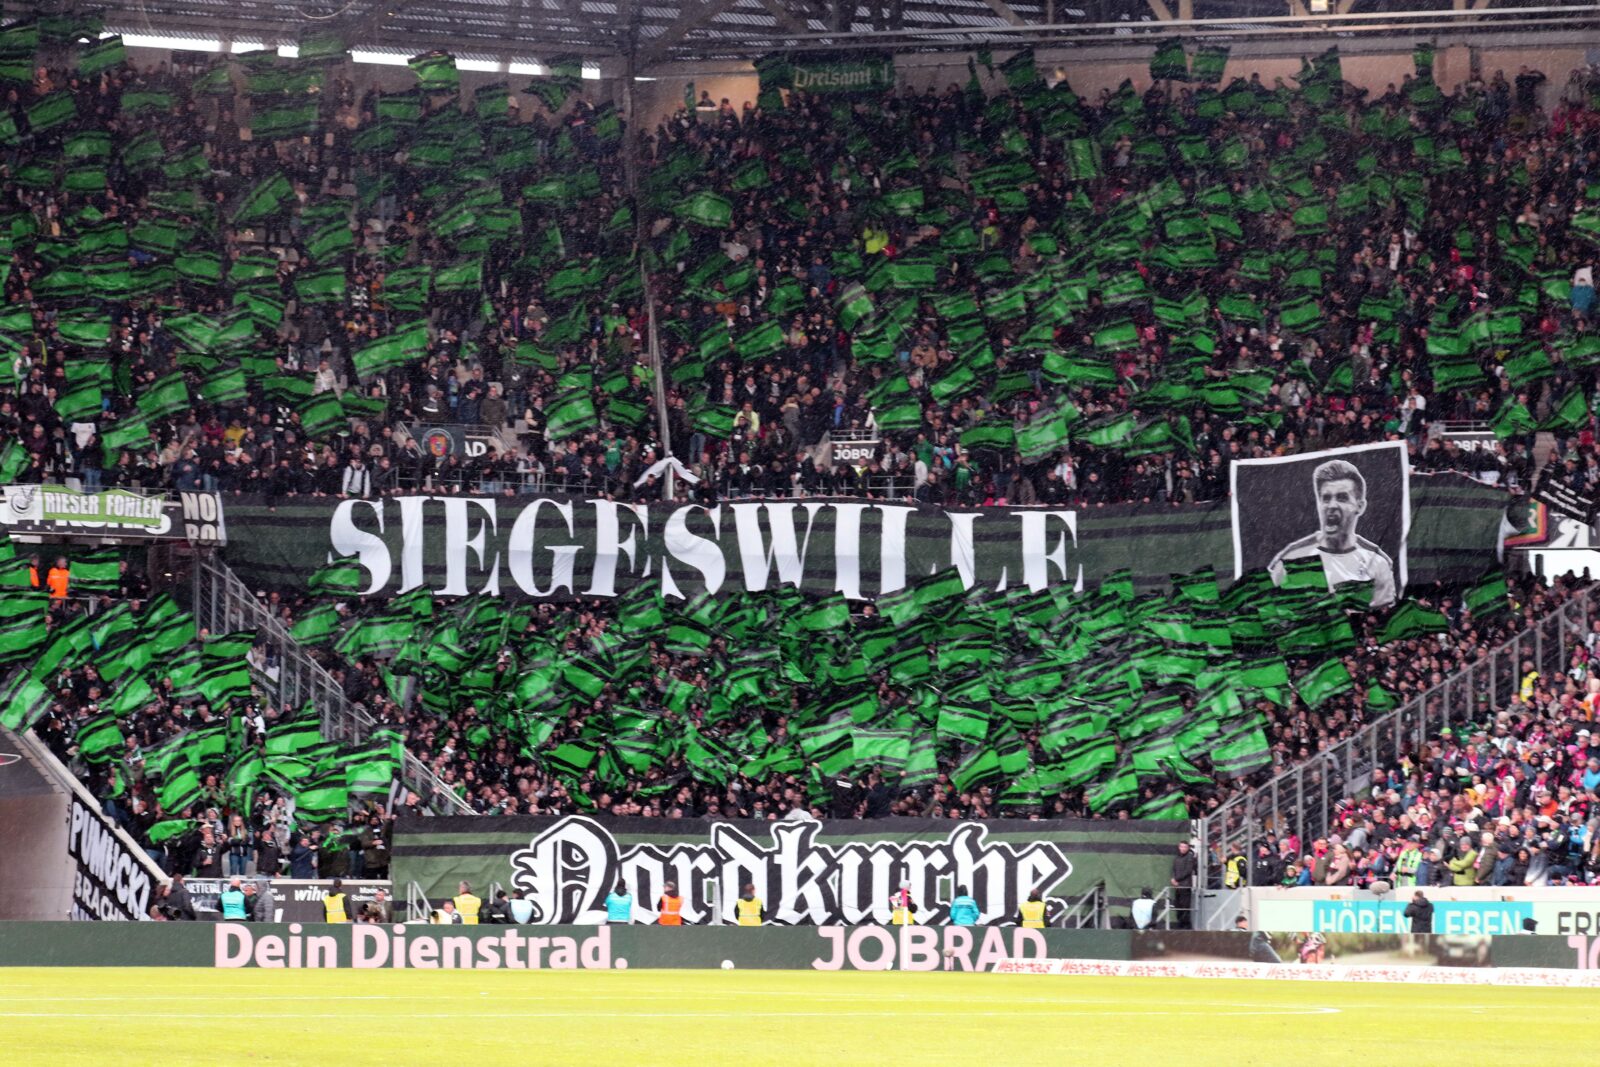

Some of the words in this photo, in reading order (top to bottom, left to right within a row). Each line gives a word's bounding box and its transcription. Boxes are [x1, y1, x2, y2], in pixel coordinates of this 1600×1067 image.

[45, 492, 99, 515] RIESER
[106, 494, 162, 519] FOHLEN
[328, 496, 1083, 601] SIEGESWILLE
[1319, 902, 1412, 933] HÖREN
[1431, 910, 1521, 935] EBEN
[215, 923, 338, 968] Dein
[352, 923, 628, 969] Dienstrad.
[811, 925, 1048, 971] JOBRAD
